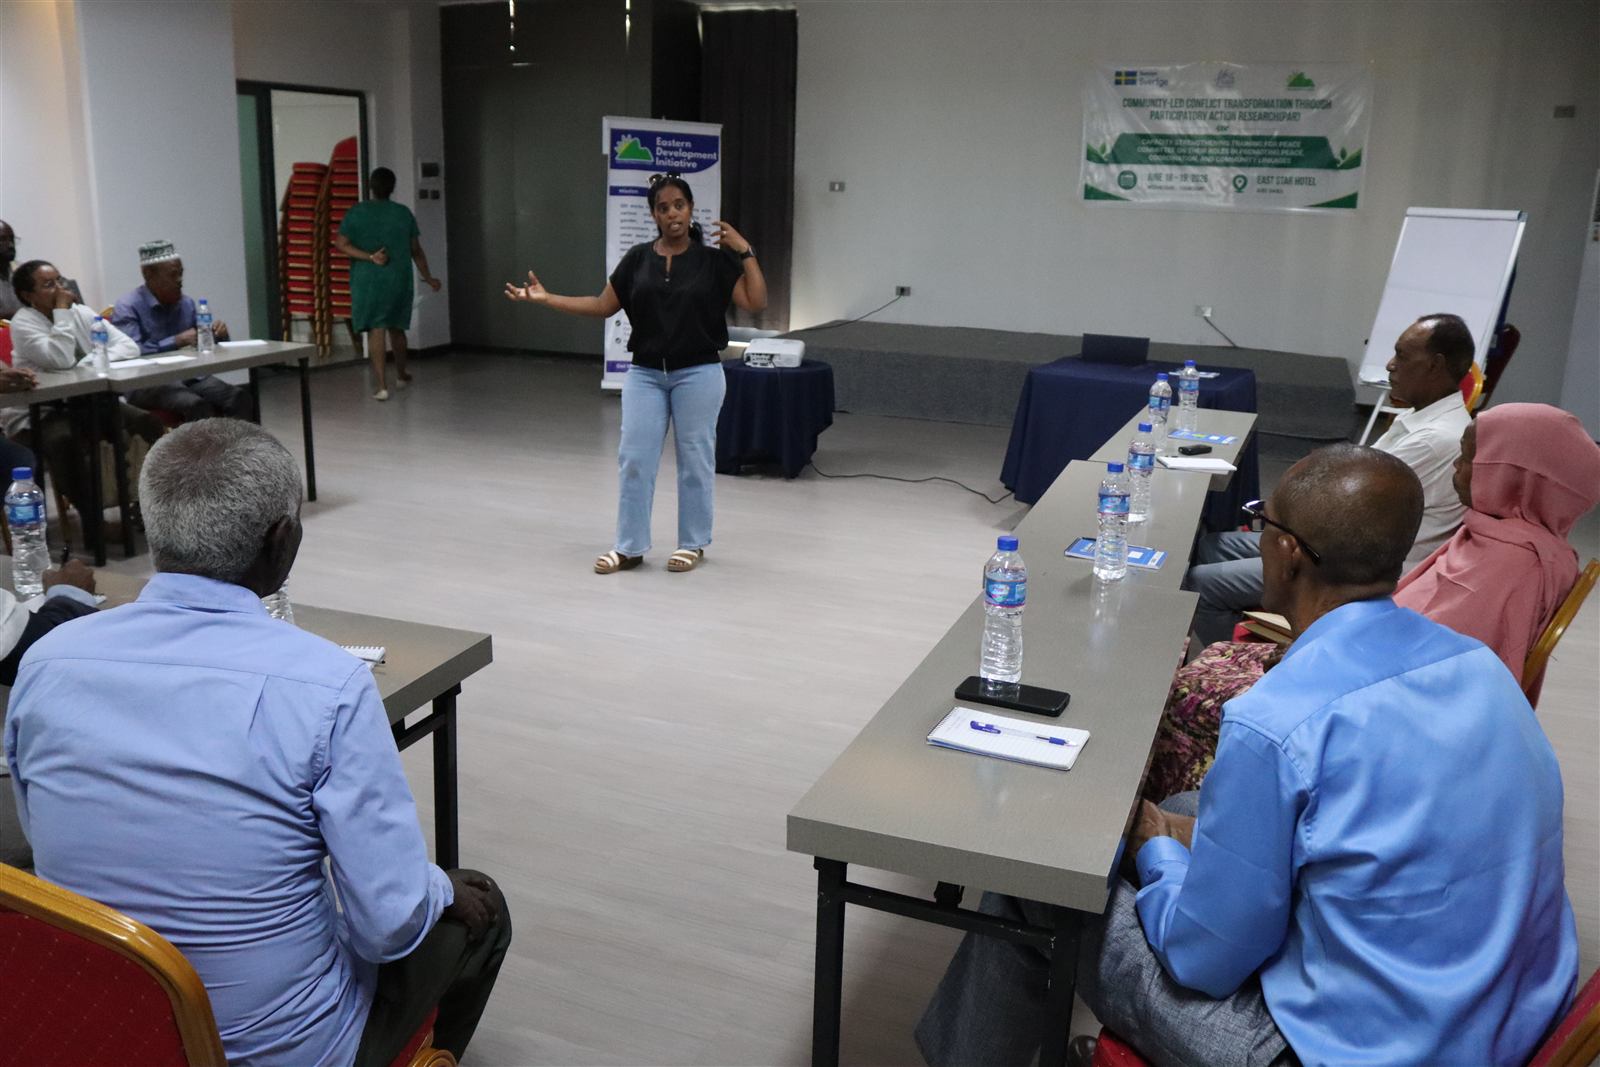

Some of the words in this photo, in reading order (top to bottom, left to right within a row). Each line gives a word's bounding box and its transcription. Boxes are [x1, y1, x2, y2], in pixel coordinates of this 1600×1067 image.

[1122, 98, 1185, 108] COMMUNITY-LED
[1186, 98, 1222, 108] CONFLICT
[1224, 99, 1293, 109] TRANSFORMATION
[1295, 99, 1332, 110] THROUGH
[1150, 110, 1208, 121] PARTICIPATORY
[1209, 111, 1236, 121] ACTION
[656, 136, 692, 148] Eastern
[656, 147, 718, 160] Development
[656, 157, 698, 169] Initiative
[1256, 176, 1274, 185] EAST
[1276, 176, 1293, 185] STAR
[1294, 176, 1316, 186] HOTEL
